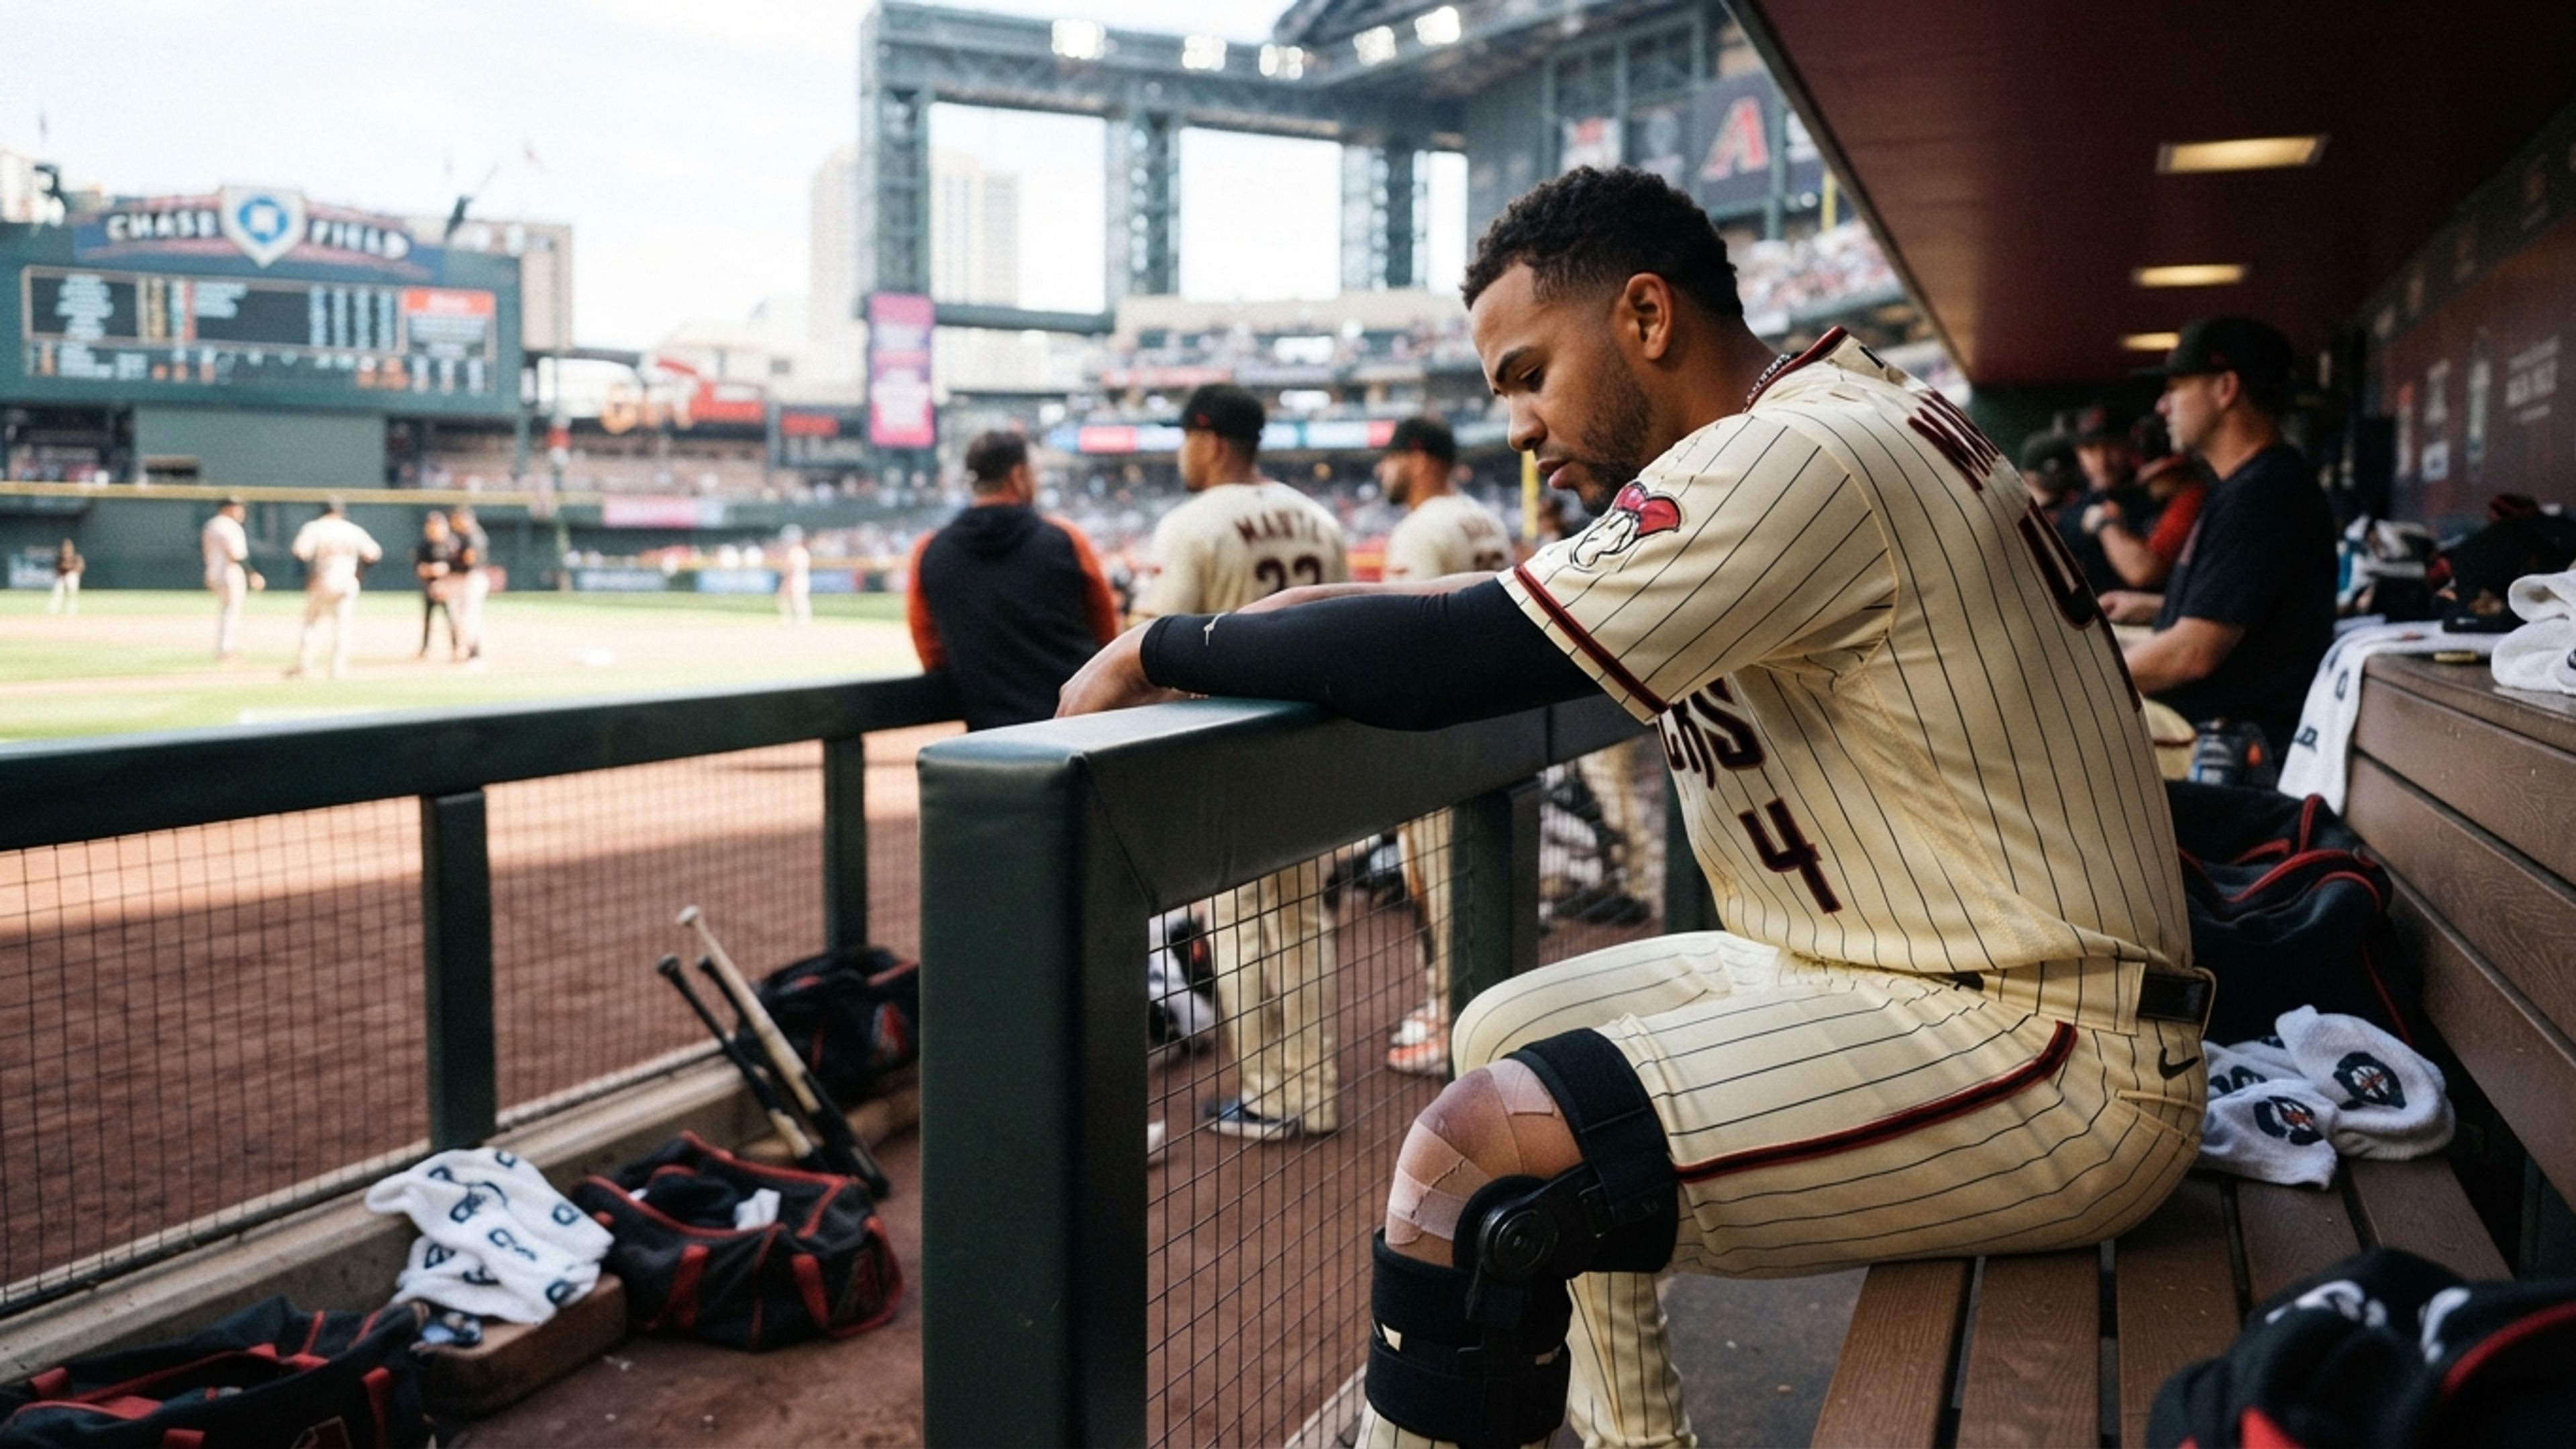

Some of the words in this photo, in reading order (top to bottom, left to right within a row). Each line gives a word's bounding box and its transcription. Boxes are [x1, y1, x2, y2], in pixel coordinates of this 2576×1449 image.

[106, 211, 217, 239] CHASE
[311, 219, 411, 260] FIELD
[1739, 797, 1843, 914] 4
